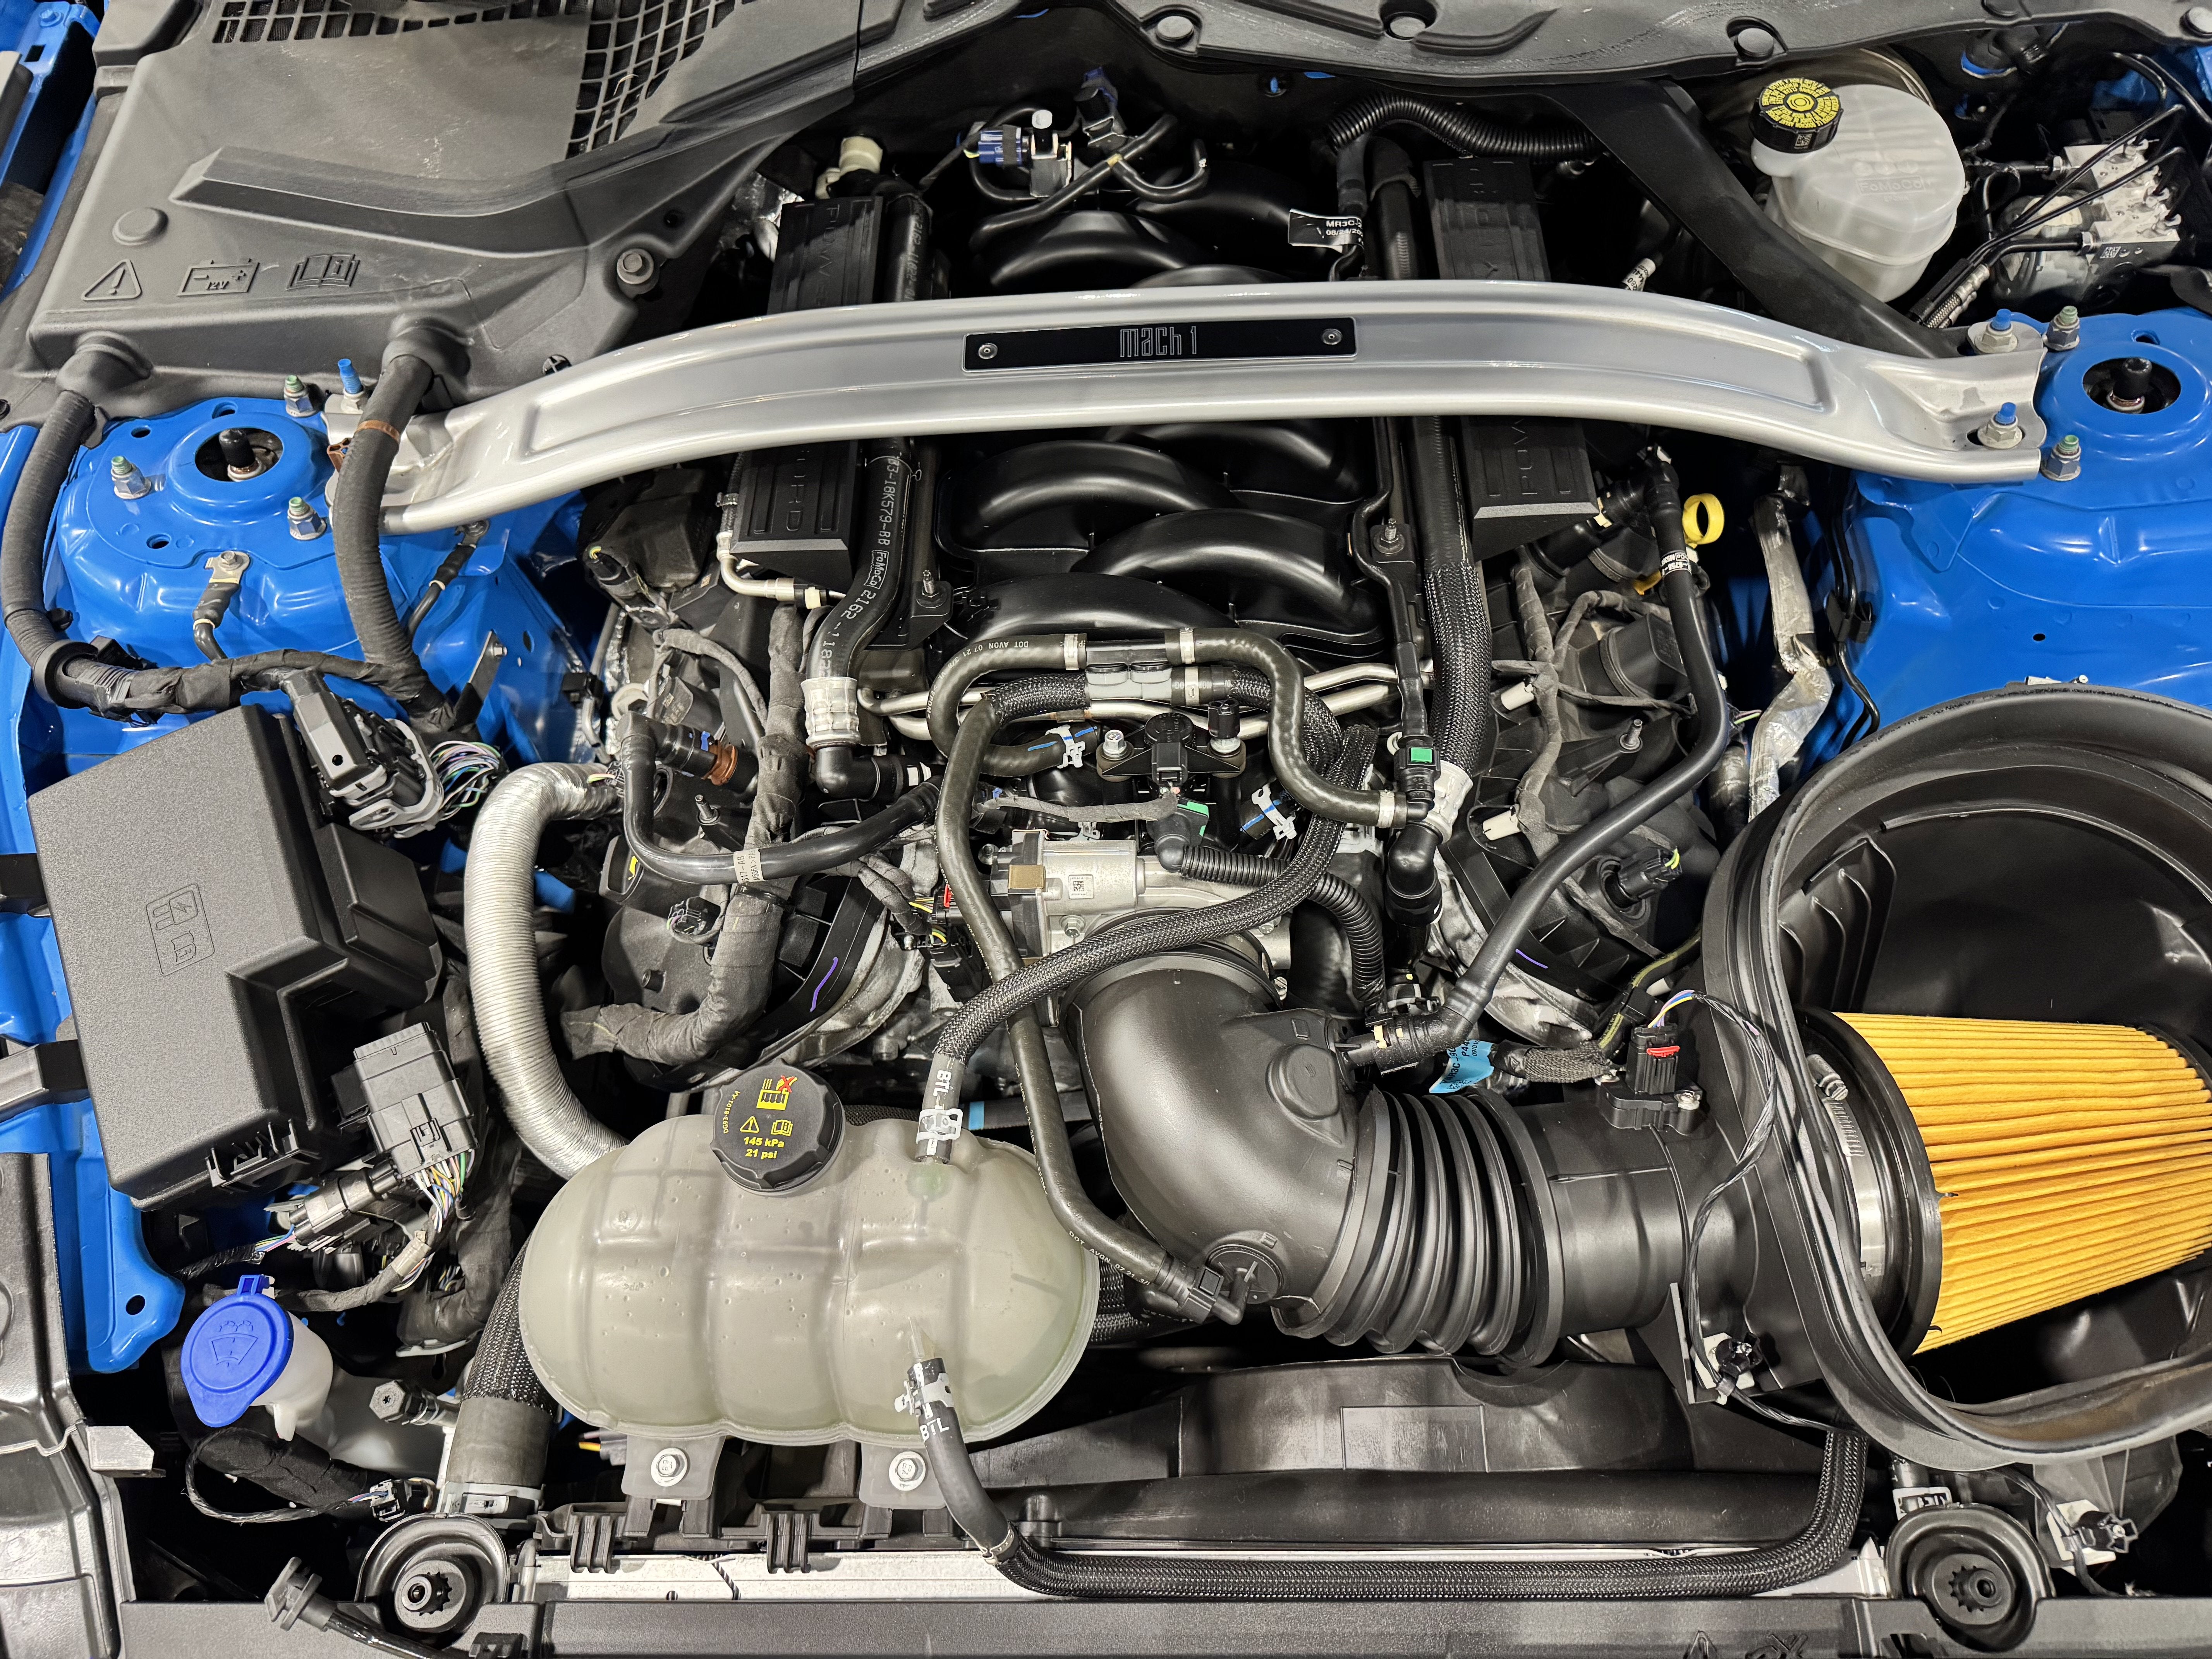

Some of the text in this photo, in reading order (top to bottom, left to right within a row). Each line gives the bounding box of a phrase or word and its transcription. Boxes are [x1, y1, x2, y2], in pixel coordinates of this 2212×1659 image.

[1859, 179, 1922, 192] FoMoCo
[205, 280, 229, 290] 12V
[1190, 326, 1197, 354] 1
[869, 551, 888, 586] FoMoCo
[974, 644, 983, 653] 07
[988, 641, 1009, 649] AVON
[963, 648, 972, 657] 21
[947, 656, 960, 669] 3/8
[722, 1090, 740, 1134] DG93-8101-AA
[743, 1136, 785, 1148] 145 kPa
[745, 1148, 778, 1160] 21 psi
[1069, 1231, 1085, 1245] DOT
[1089, 1249, 1111, 1263] AVON
[919, 1417, 950, 1443] BTL
